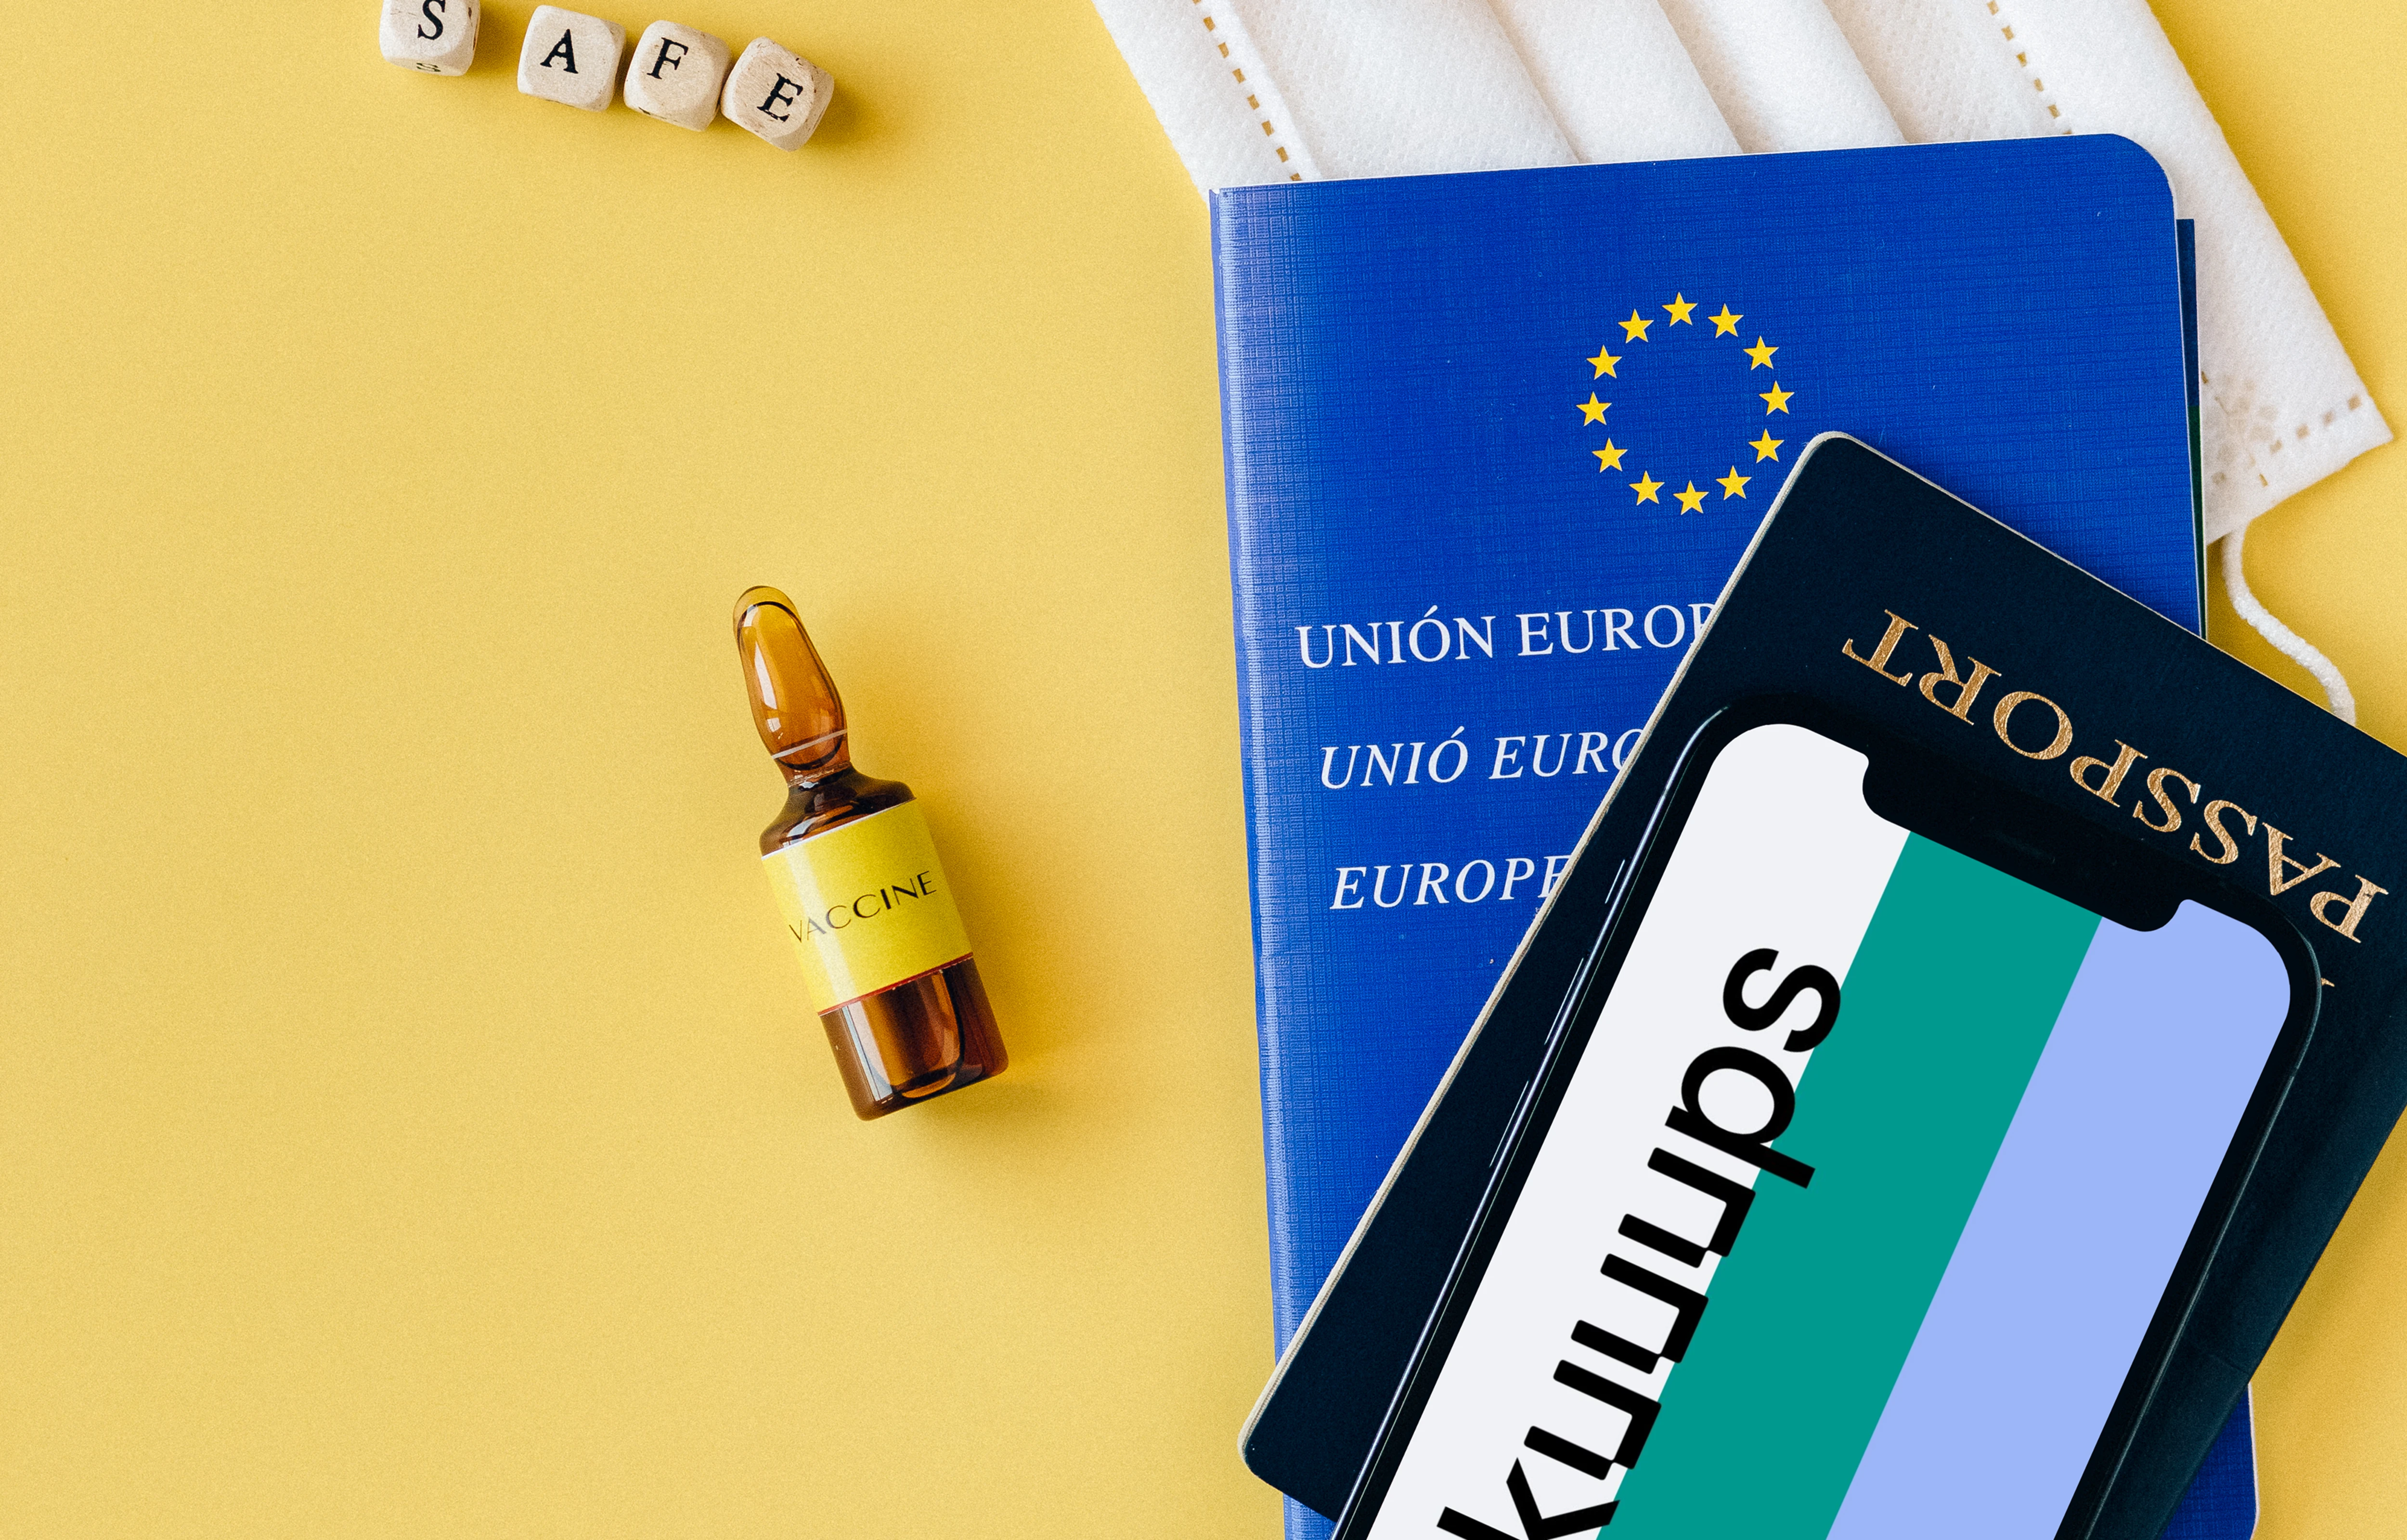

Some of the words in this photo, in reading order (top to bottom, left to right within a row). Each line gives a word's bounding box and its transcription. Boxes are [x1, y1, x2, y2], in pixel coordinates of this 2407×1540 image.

[1294, 605, 1496, 668] UNIÓN
[1321, 726, 1469, 789] UNIÓ
[1842, 609, 2389, 943] PASSPORT
[789, 870, 937, 943] VACCINE
